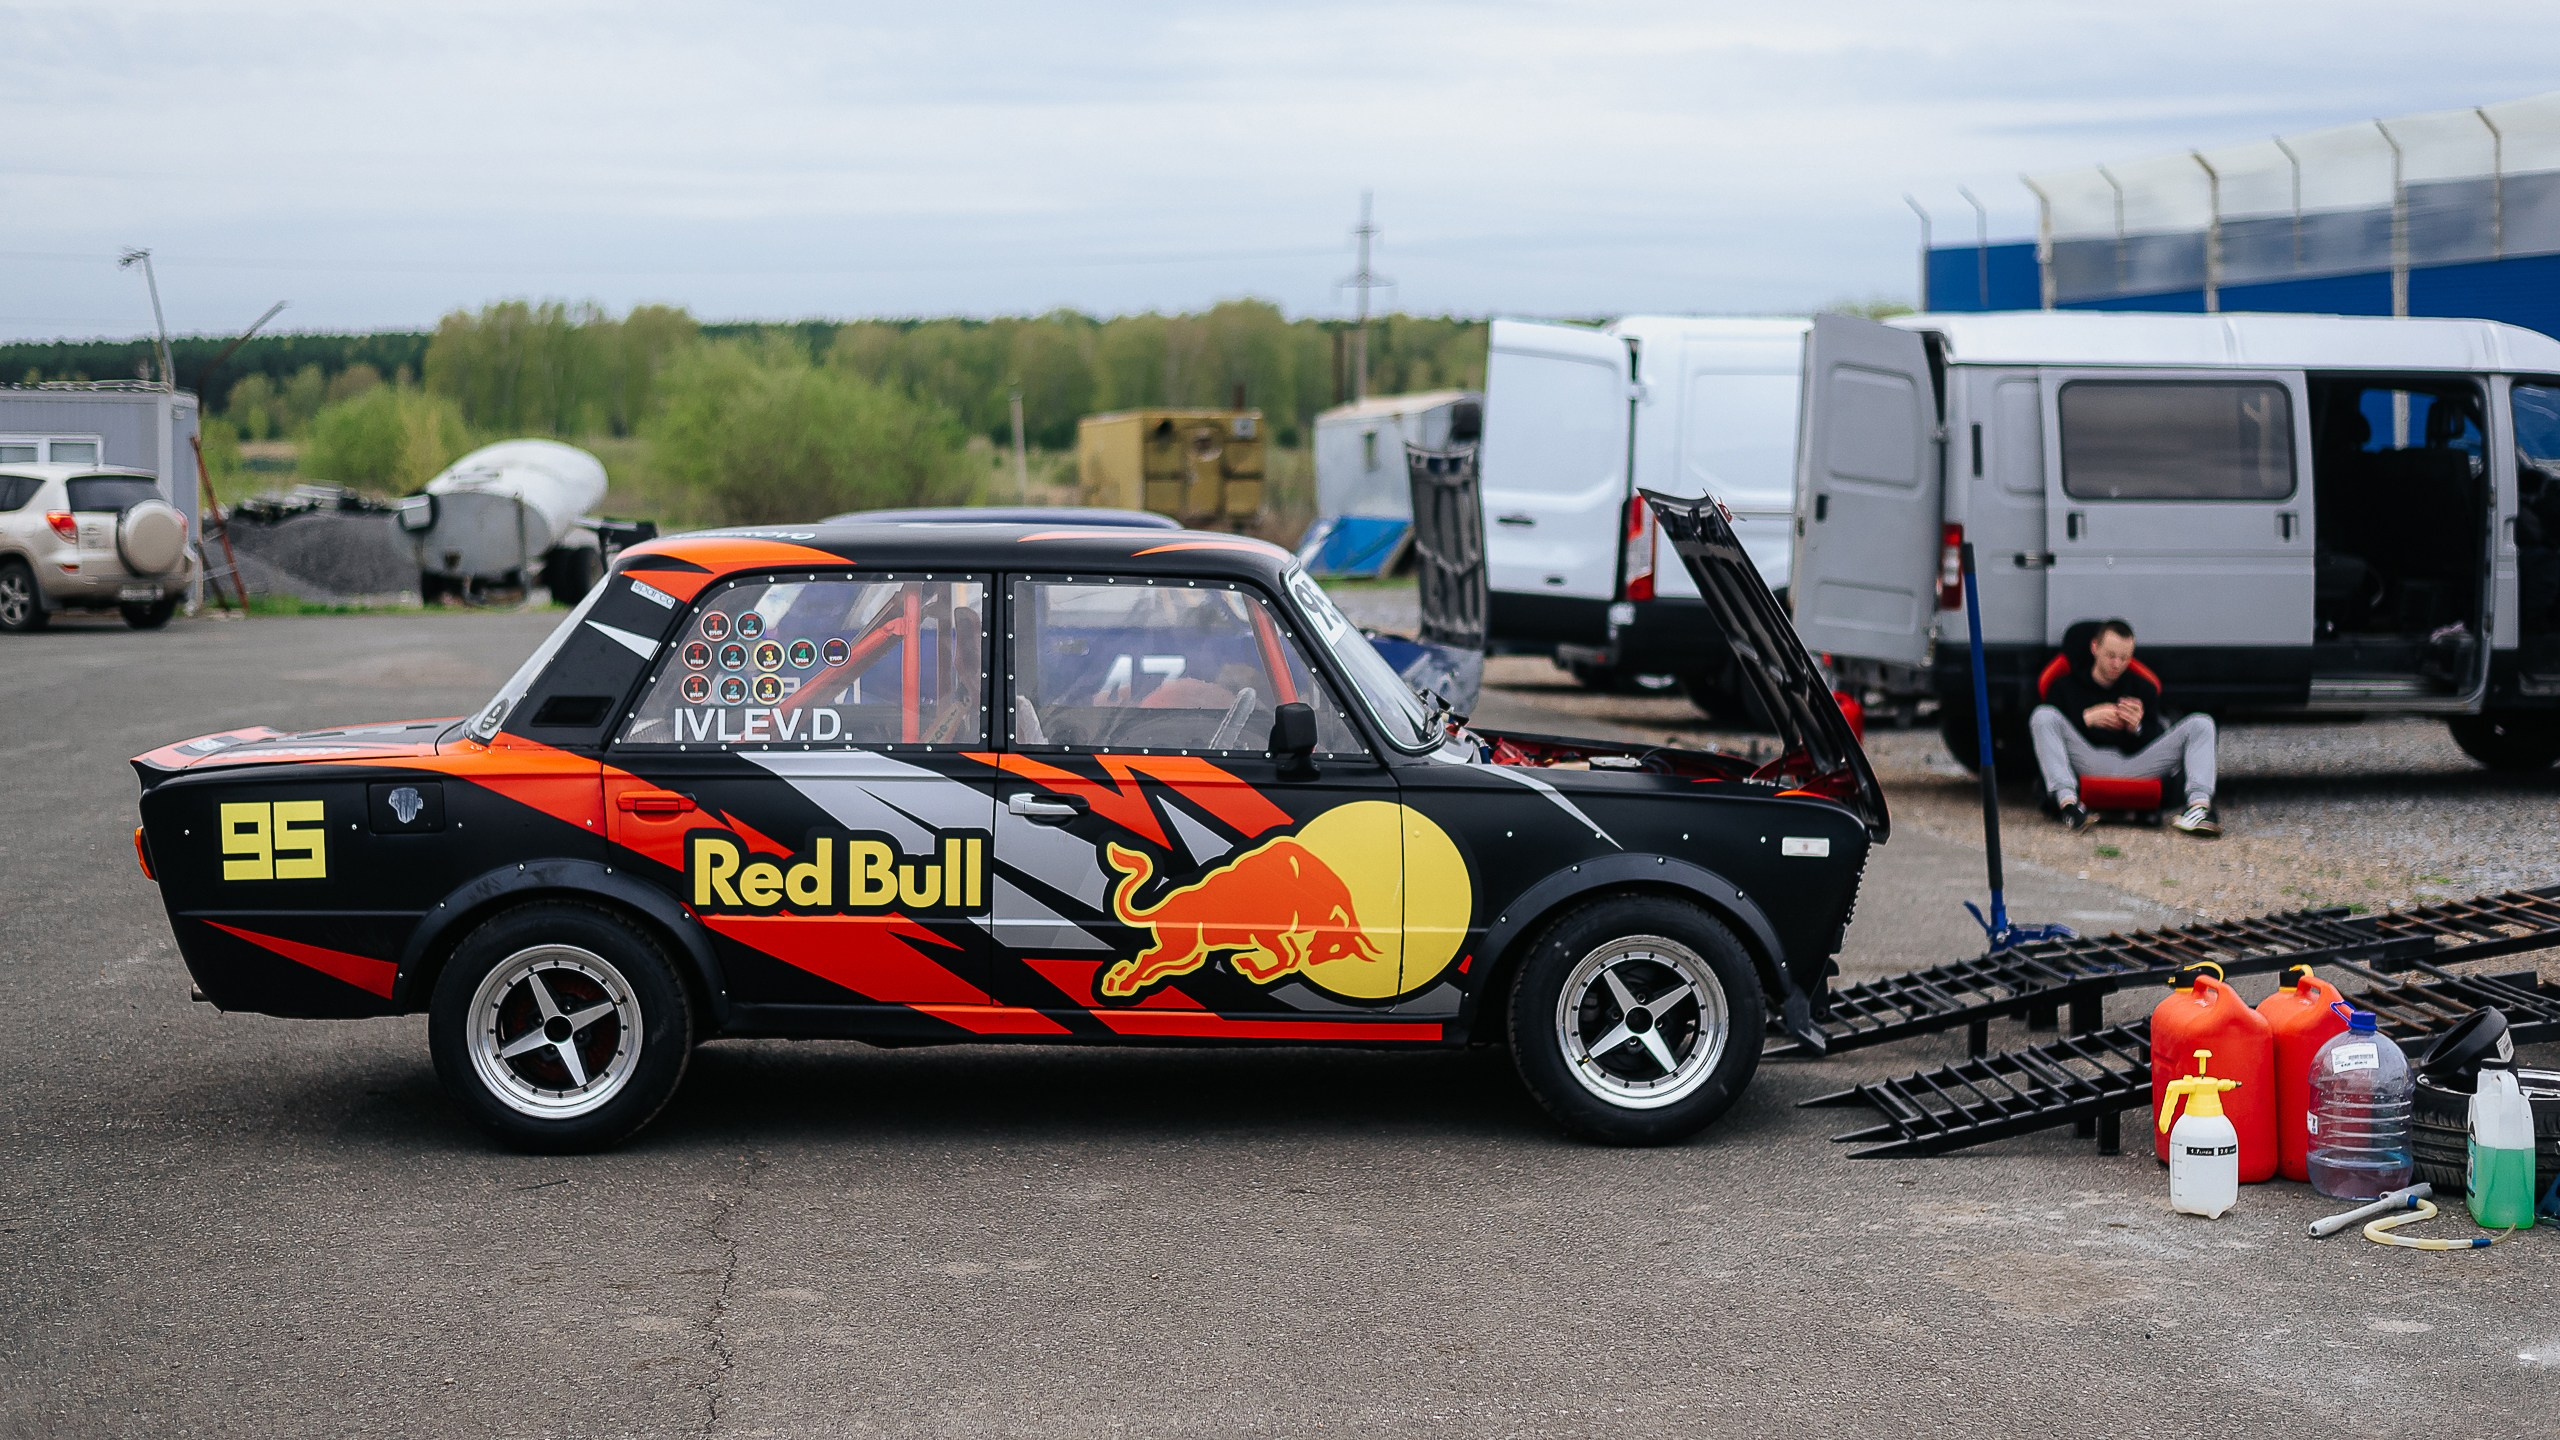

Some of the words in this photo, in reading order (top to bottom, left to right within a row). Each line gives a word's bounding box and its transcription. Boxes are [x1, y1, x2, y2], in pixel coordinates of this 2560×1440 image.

[634, 582, 674, 606] sparco
[674, 708, 853, 742] IVLEV.D.
[220, 800, 327, 881] 95
[694, 837, 833, 907] Red
[849, 838, 982, 908] Bull
